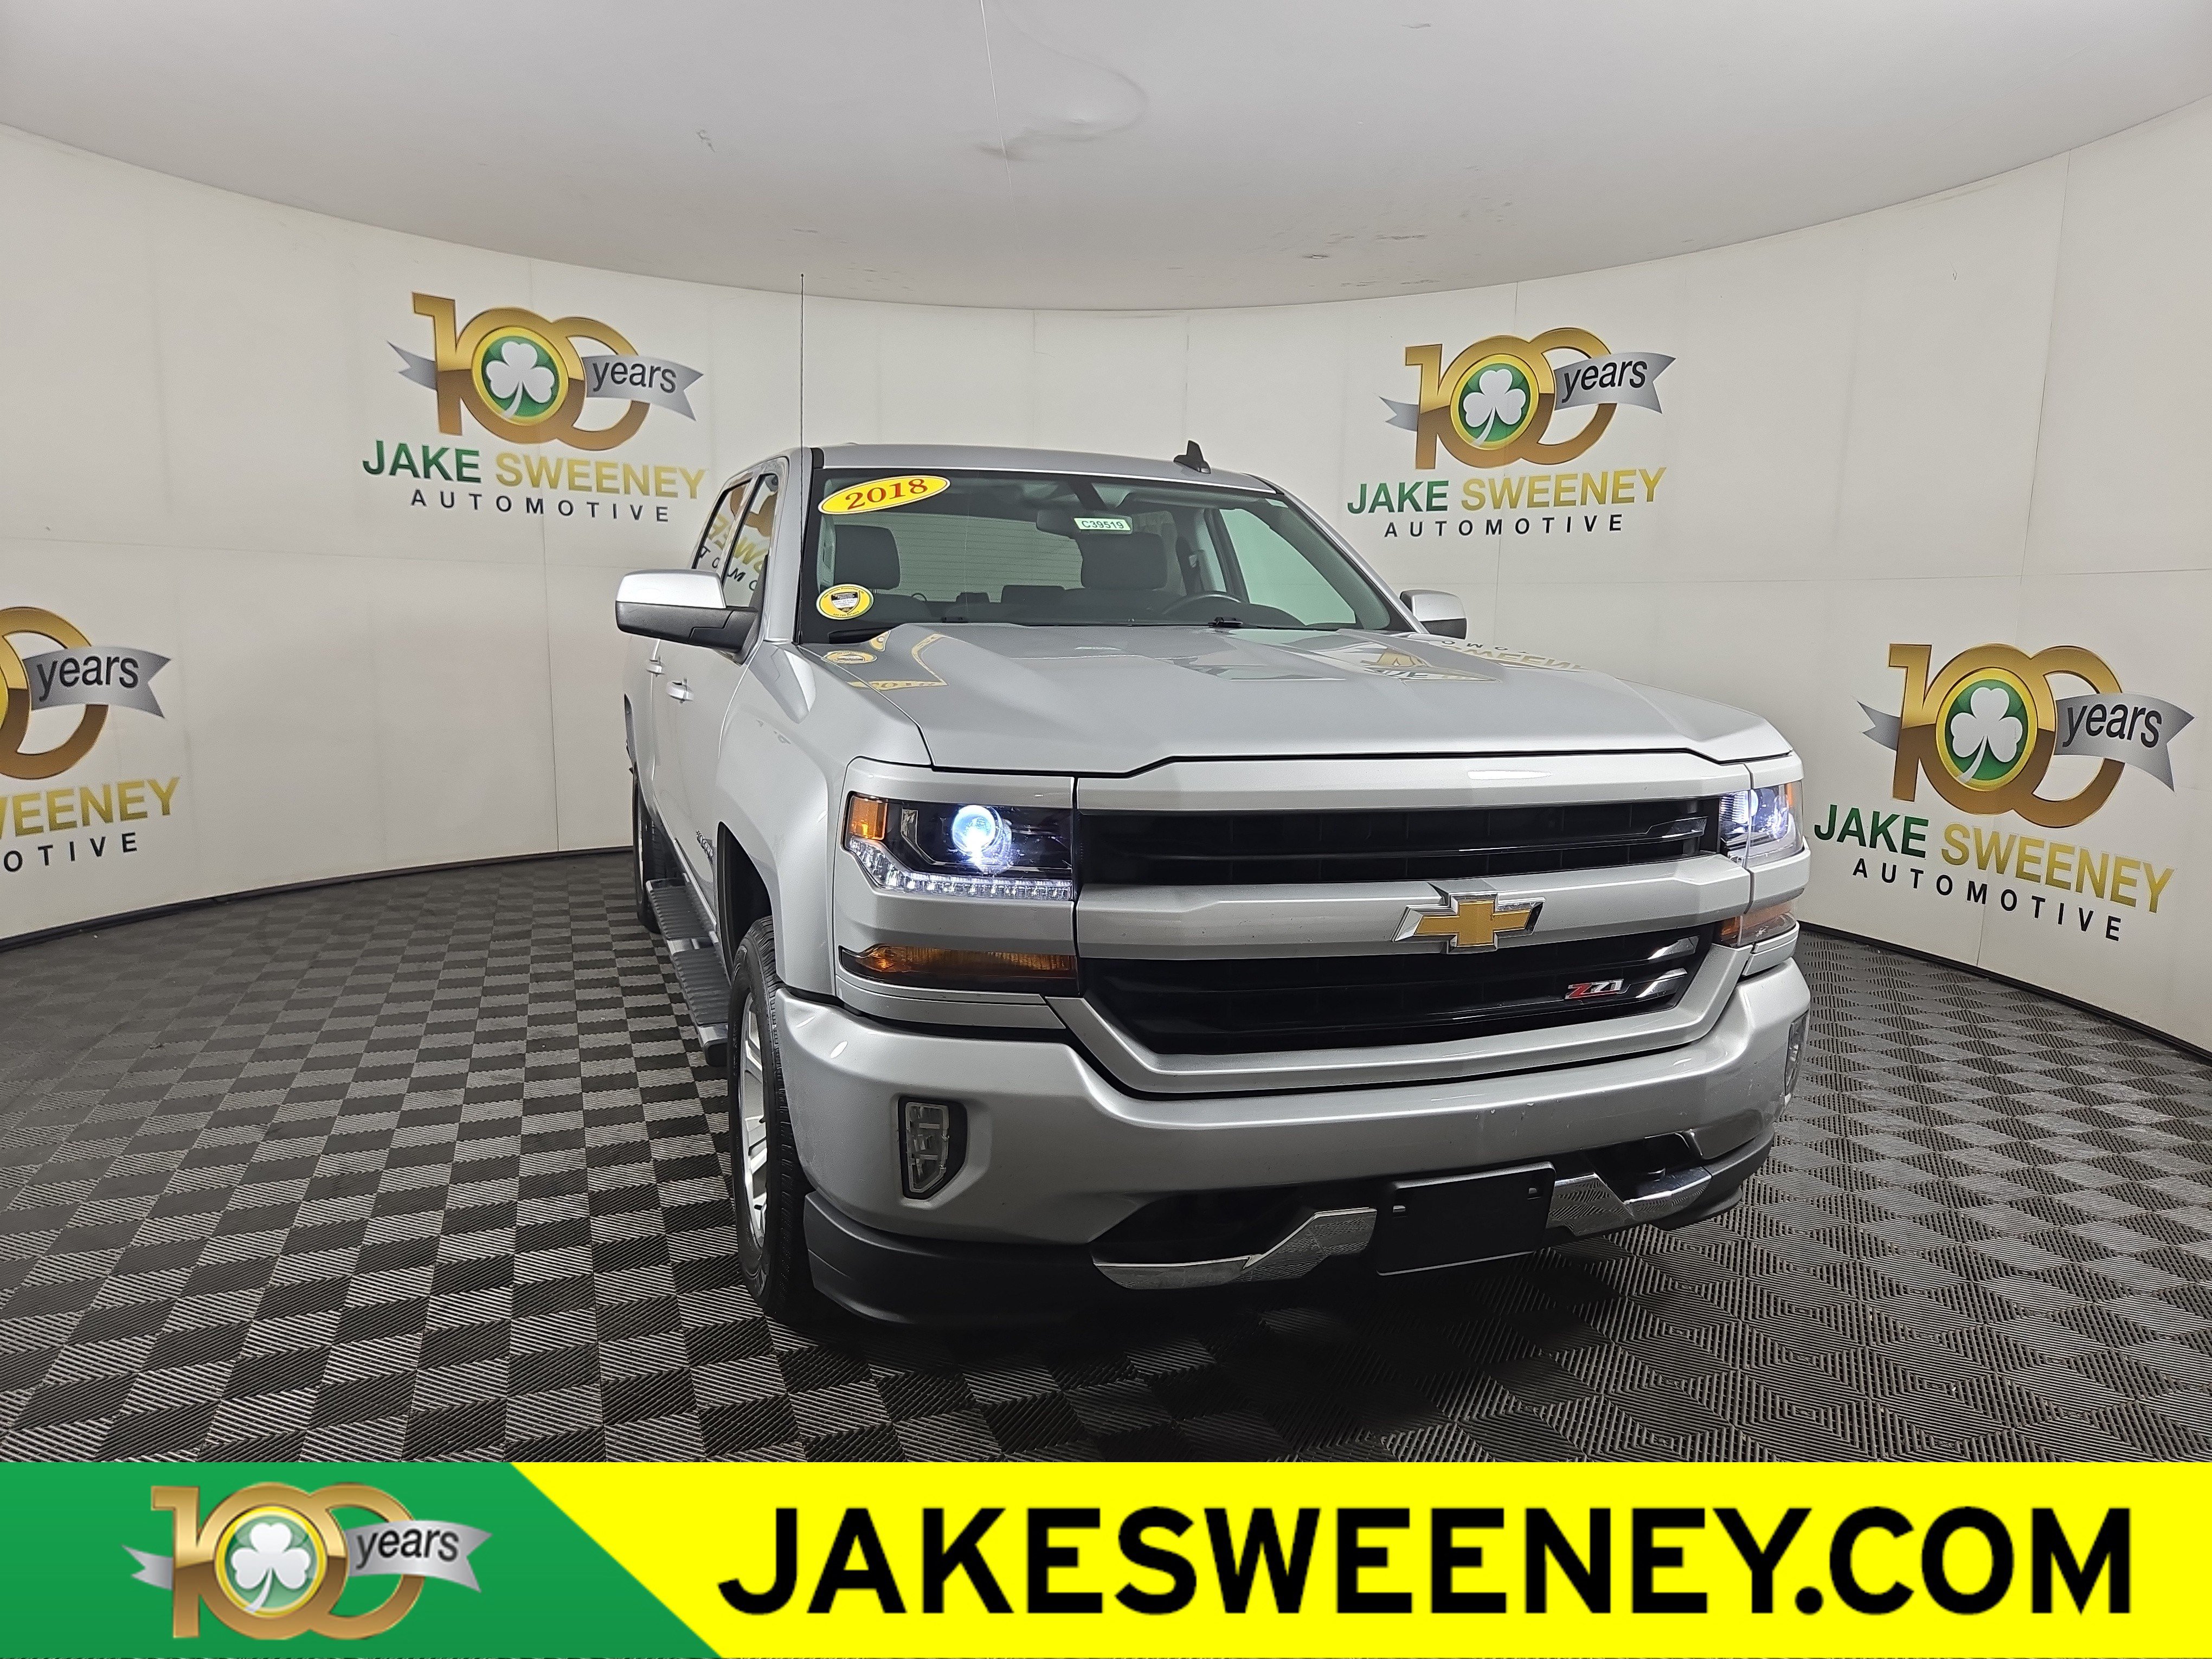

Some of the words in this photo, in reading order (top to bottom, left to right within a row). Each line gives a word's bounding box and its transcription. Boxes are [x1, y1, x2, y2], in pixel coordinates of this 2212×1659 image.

[591, 358, 677, 394] years
[1561, 359, 1648, 403] years
[362, 439, 481, 484] JAKE
[494, 452, 706, 500] SWEENEY
[1347, 480, 1450, 515] JAKE
[1461, 467, 1668, 512] SWEENEY
[410, 488, 670, 523] AUTOMOTIVE
[845, 478, 928, 511] 2018
[1081, 520, 1124, 529] C39519
[1384, 514, 1623, 538] AUTOMOTIVE
[36, 654, 139, 702] years
[2062, 703, 2163, 748] years
[1814, 803, 1929, 858] JAKE
[1941, 822, 2175, 914] SWEENEY
[1852, 858, 2123, 942] AUTOMOTIVE
[1565, 979, 1624, 1000] Z71
